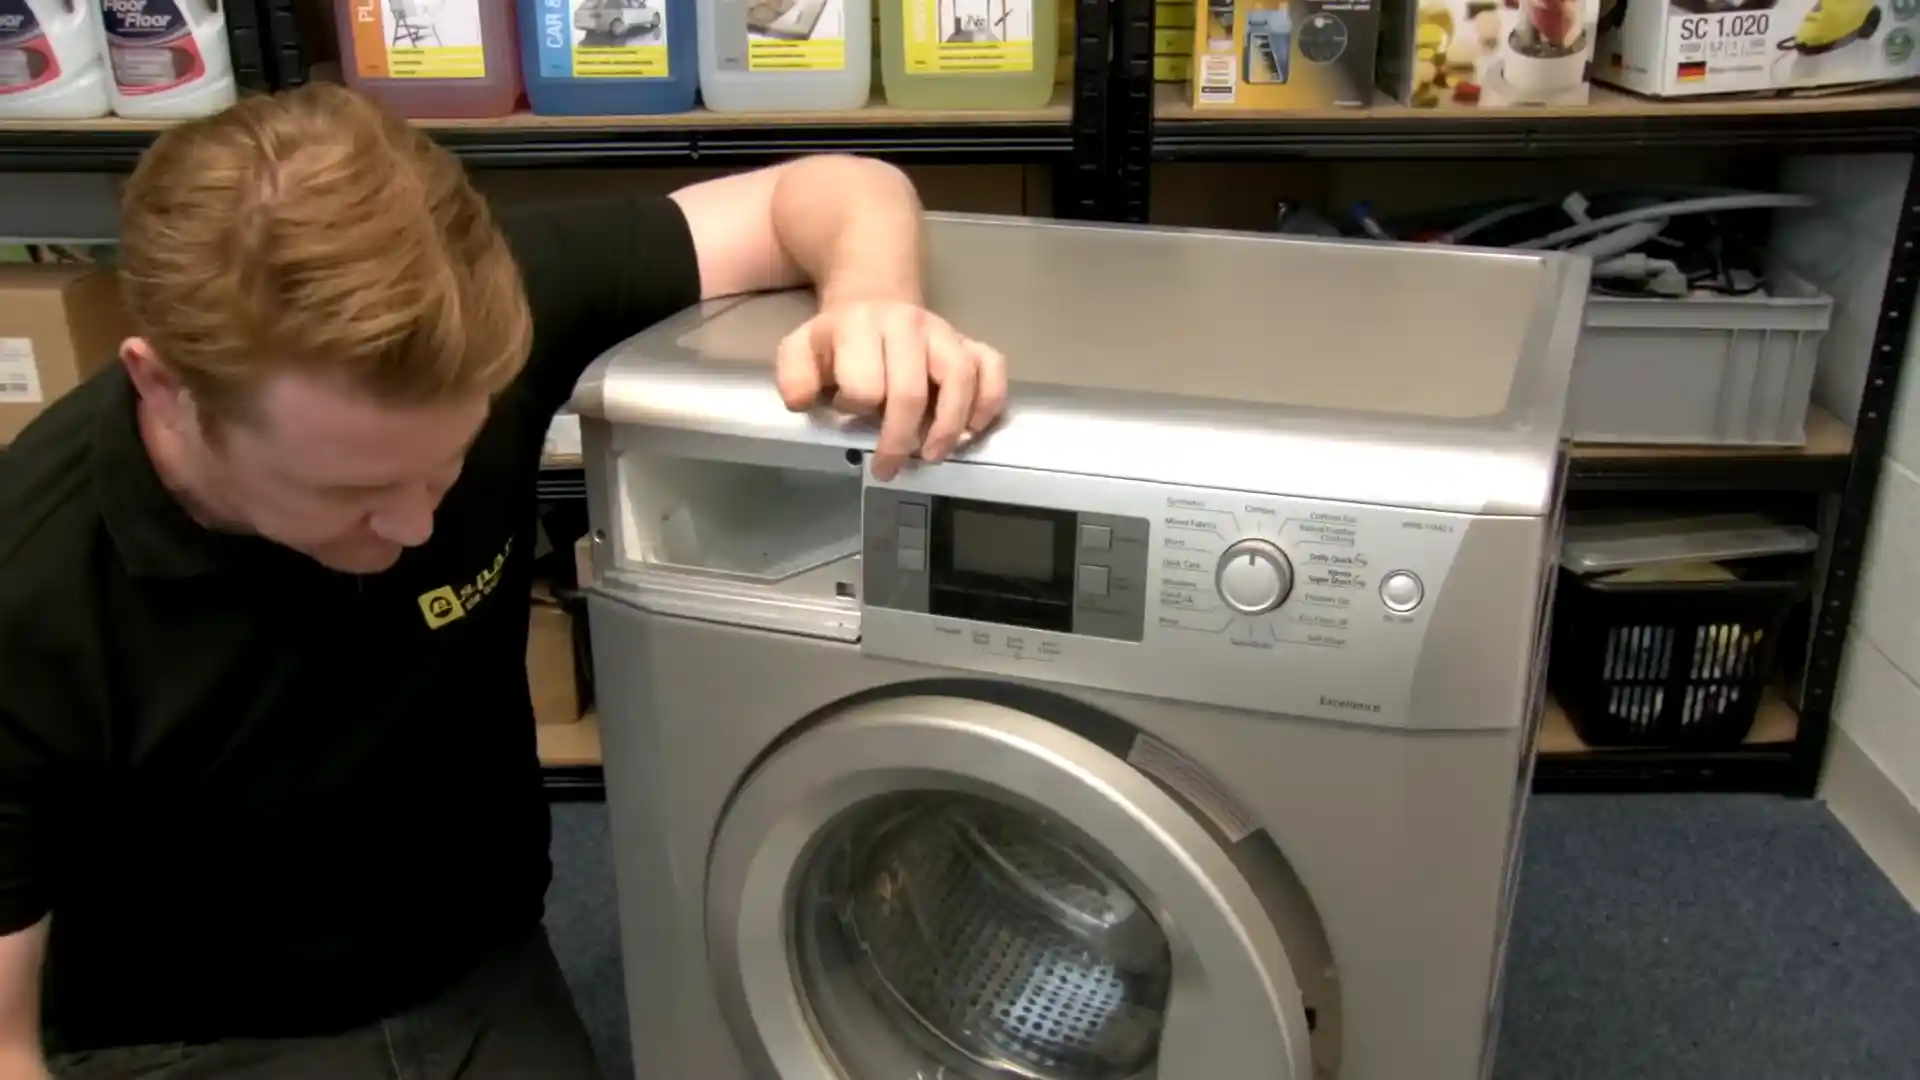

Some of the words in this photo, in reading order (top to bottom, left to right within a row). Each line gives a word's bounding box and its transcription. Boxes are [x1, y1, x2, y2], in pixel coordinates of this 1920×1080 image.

[103, 0, 147, 12] Floor
[125, 13, 172, 27] Floor
[1680, 17, 1708, 40] SC
[1716, 13, 1769, 37] 1.020
[545, 14, 563, 48] CAR
